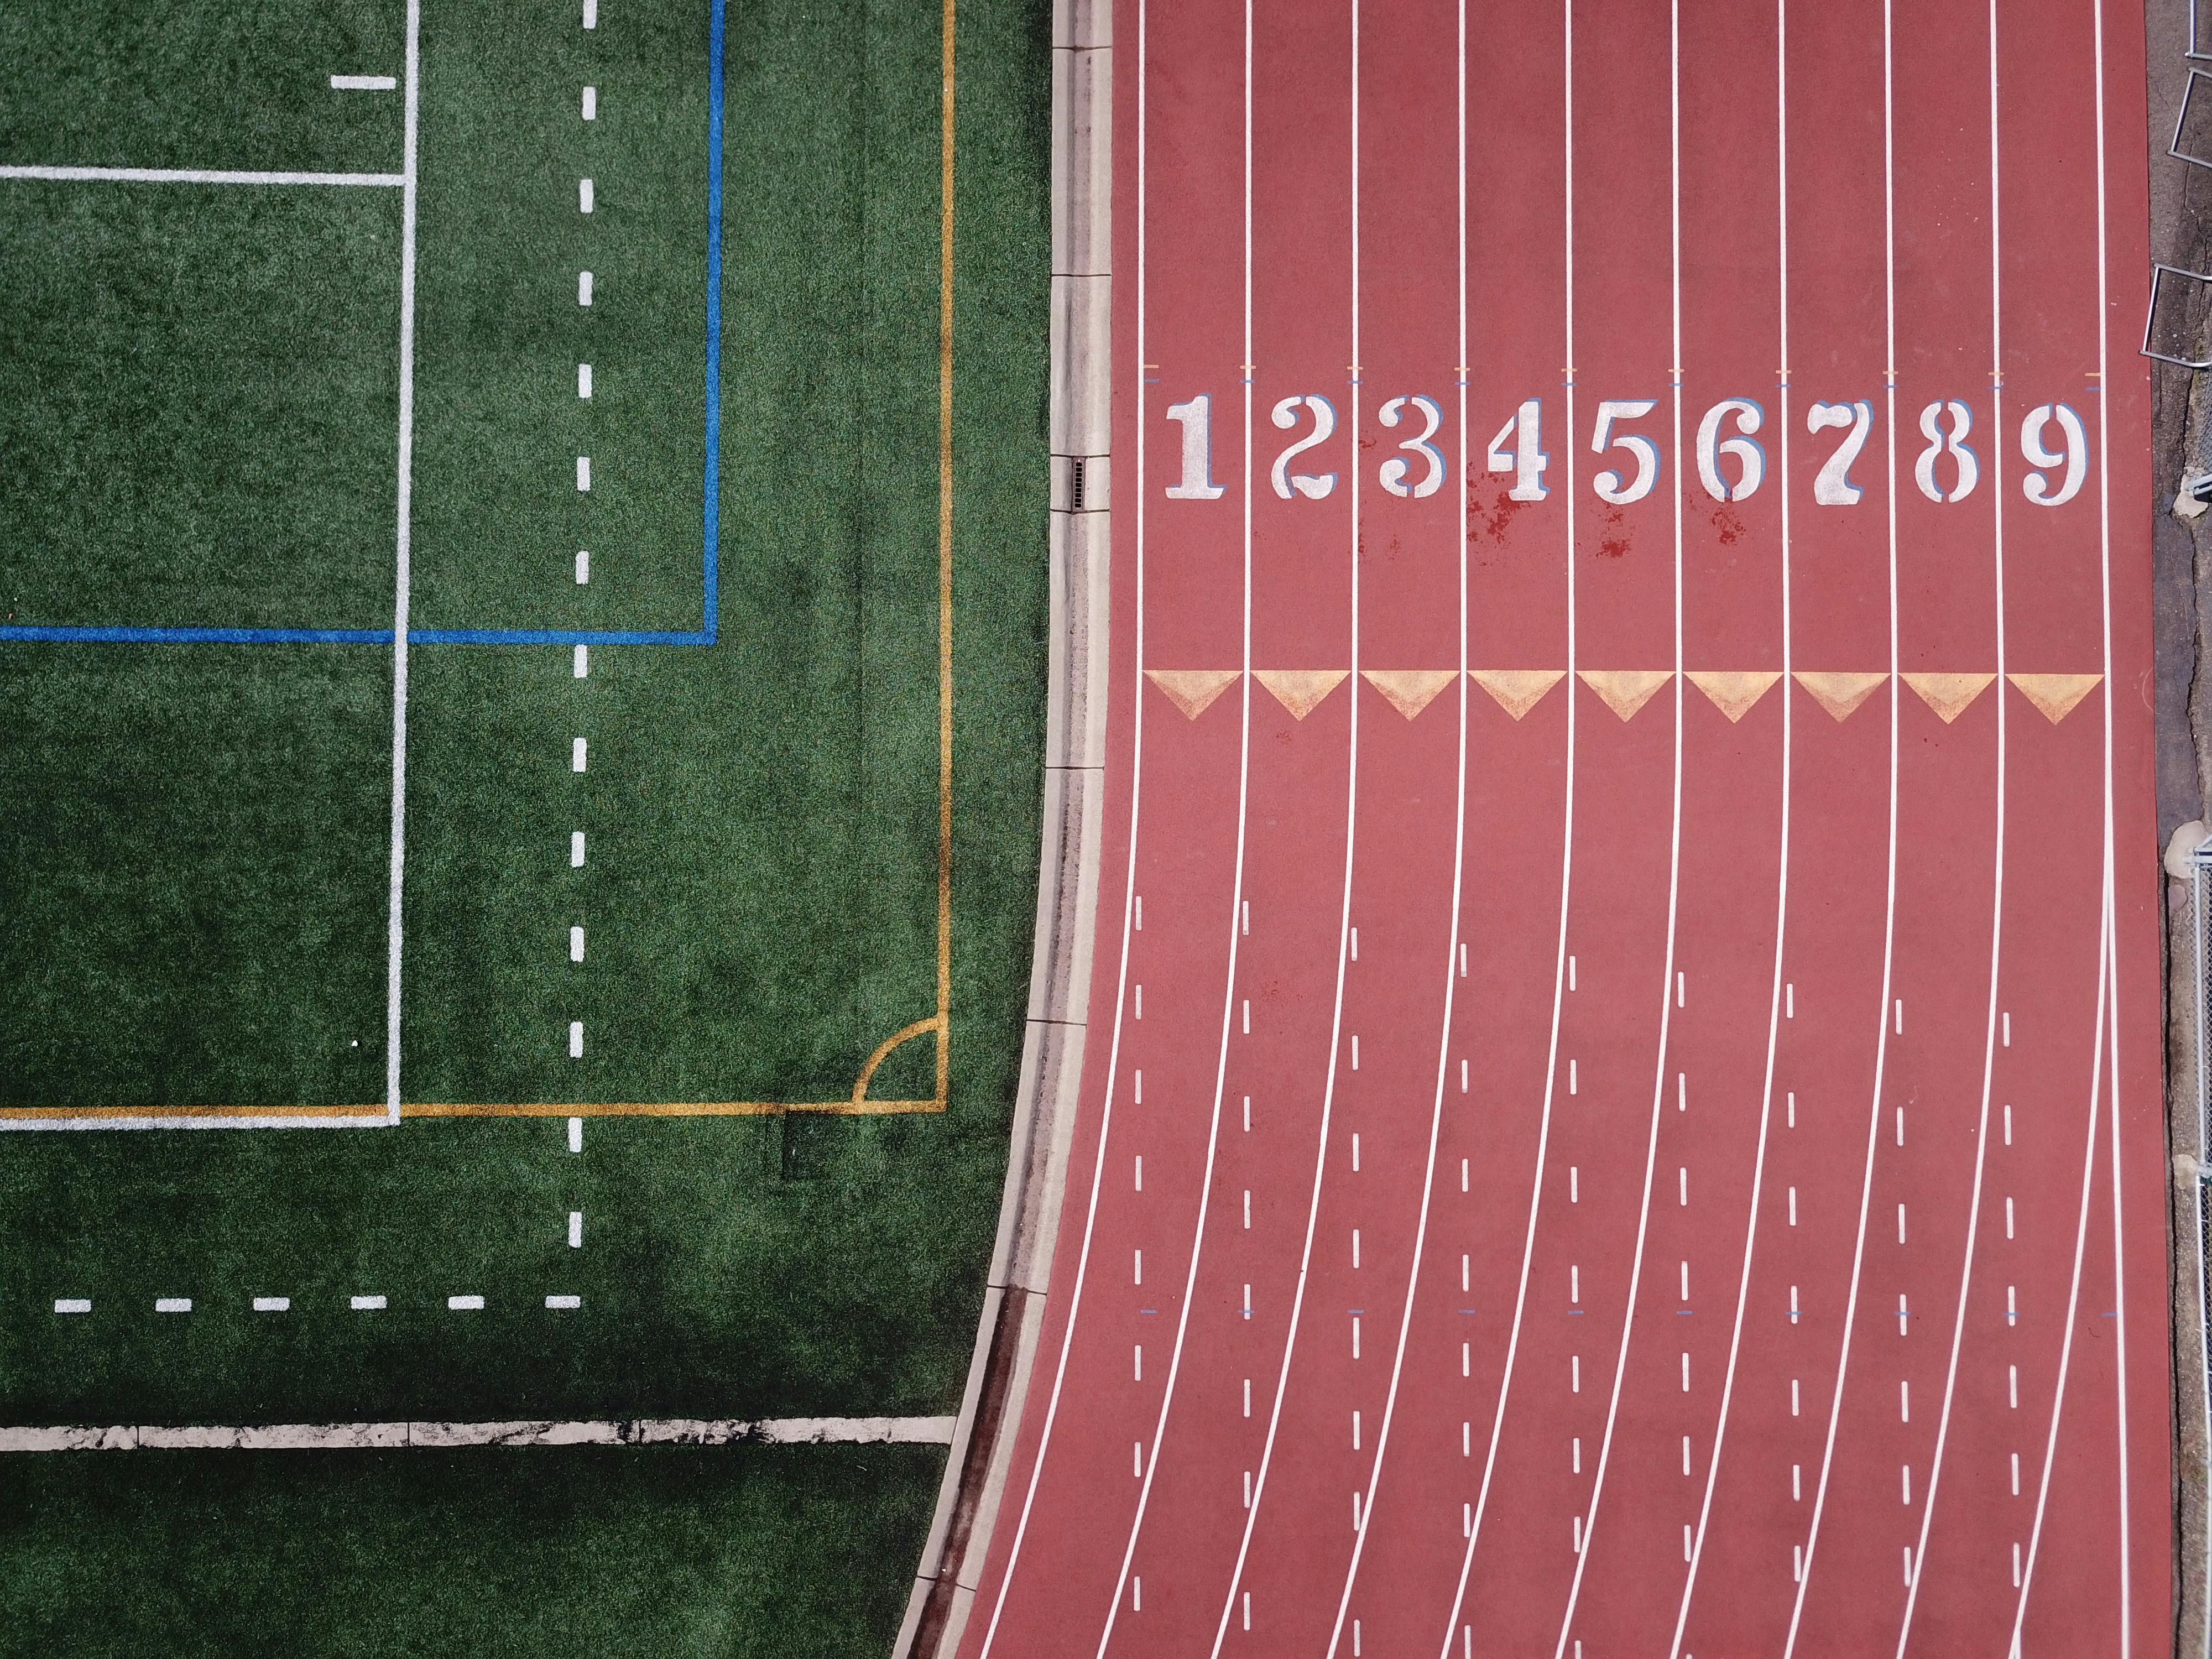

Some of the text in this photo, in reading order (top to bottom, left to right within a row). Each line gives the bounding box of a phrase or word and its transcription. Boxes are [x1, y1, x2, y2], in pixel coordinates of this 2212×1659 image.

[1165, 393, 2089, 507] 1 2 3 4 5 6 7 8 9
